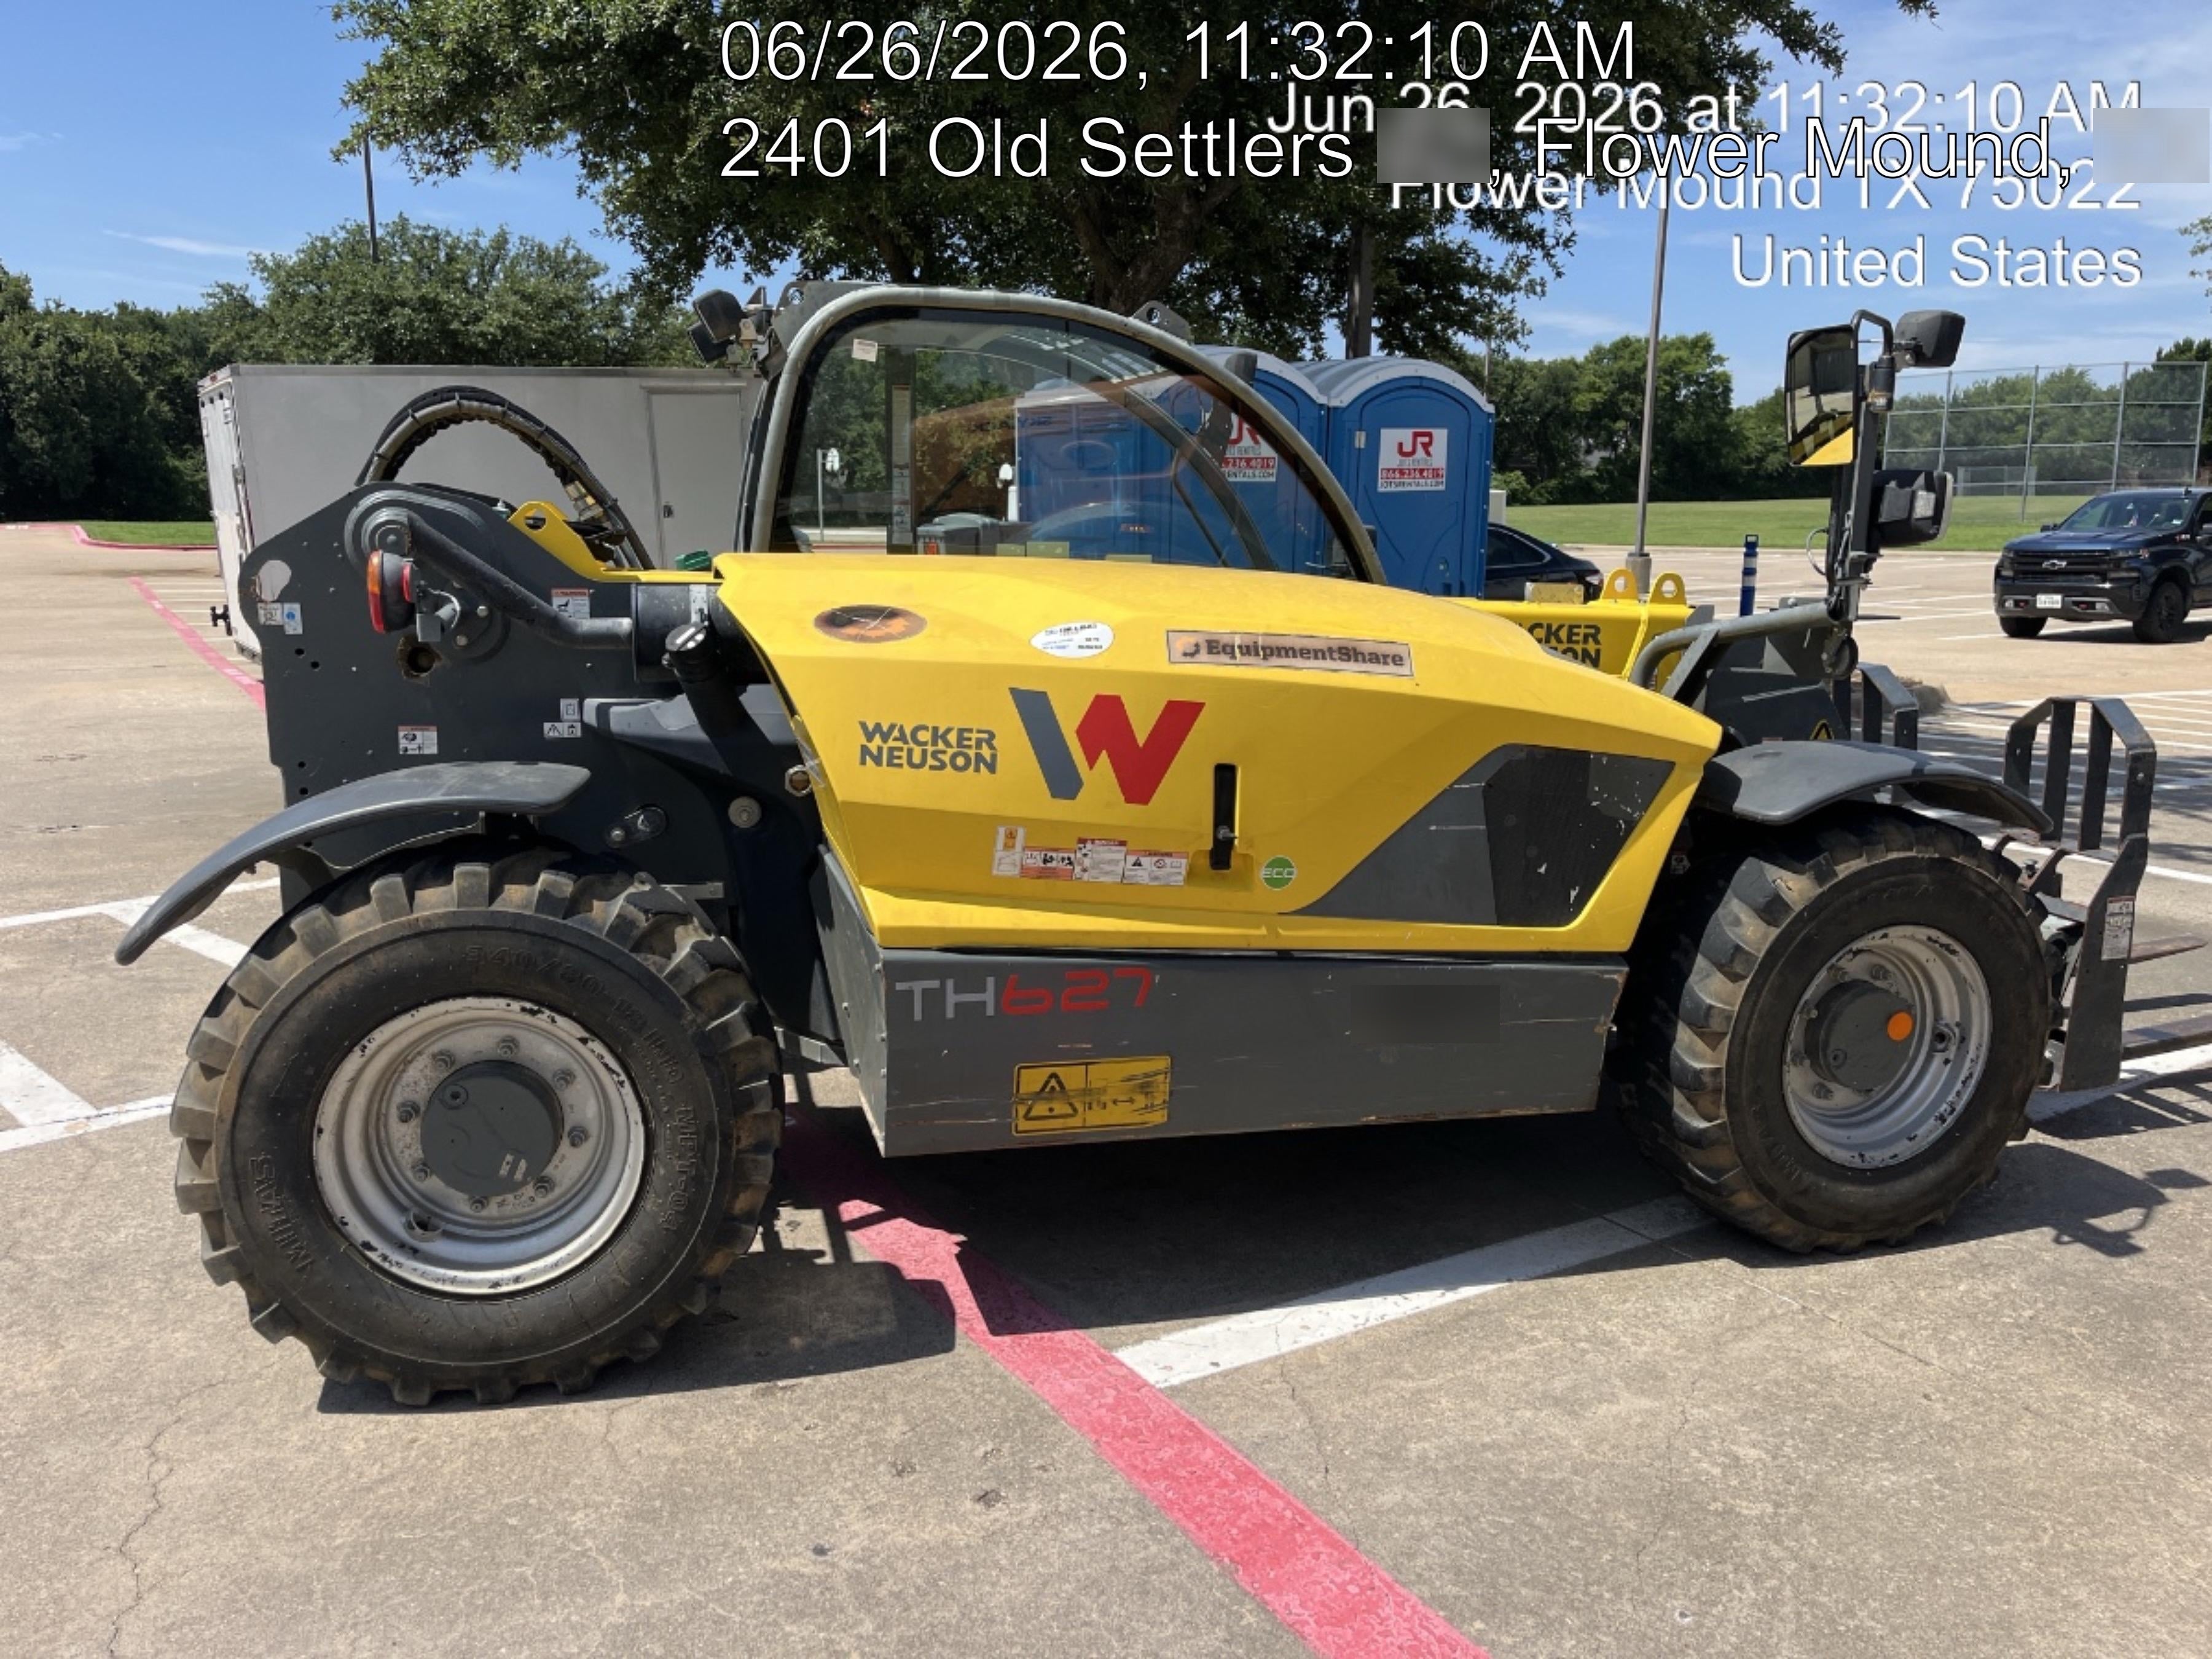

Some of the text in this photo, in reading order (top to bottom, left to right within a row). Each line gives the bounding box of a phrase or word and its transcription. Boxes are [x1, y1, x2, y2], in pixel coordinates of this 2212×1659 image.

[1397, 431, 1433, 458] JR
[1205, 639, 1405, 667] EquipmentShare
[858, 720, 998, 751] WACKER
[859, 744, 998, 775] NEUSON
[895, 967, 1153, 1022] TH627
